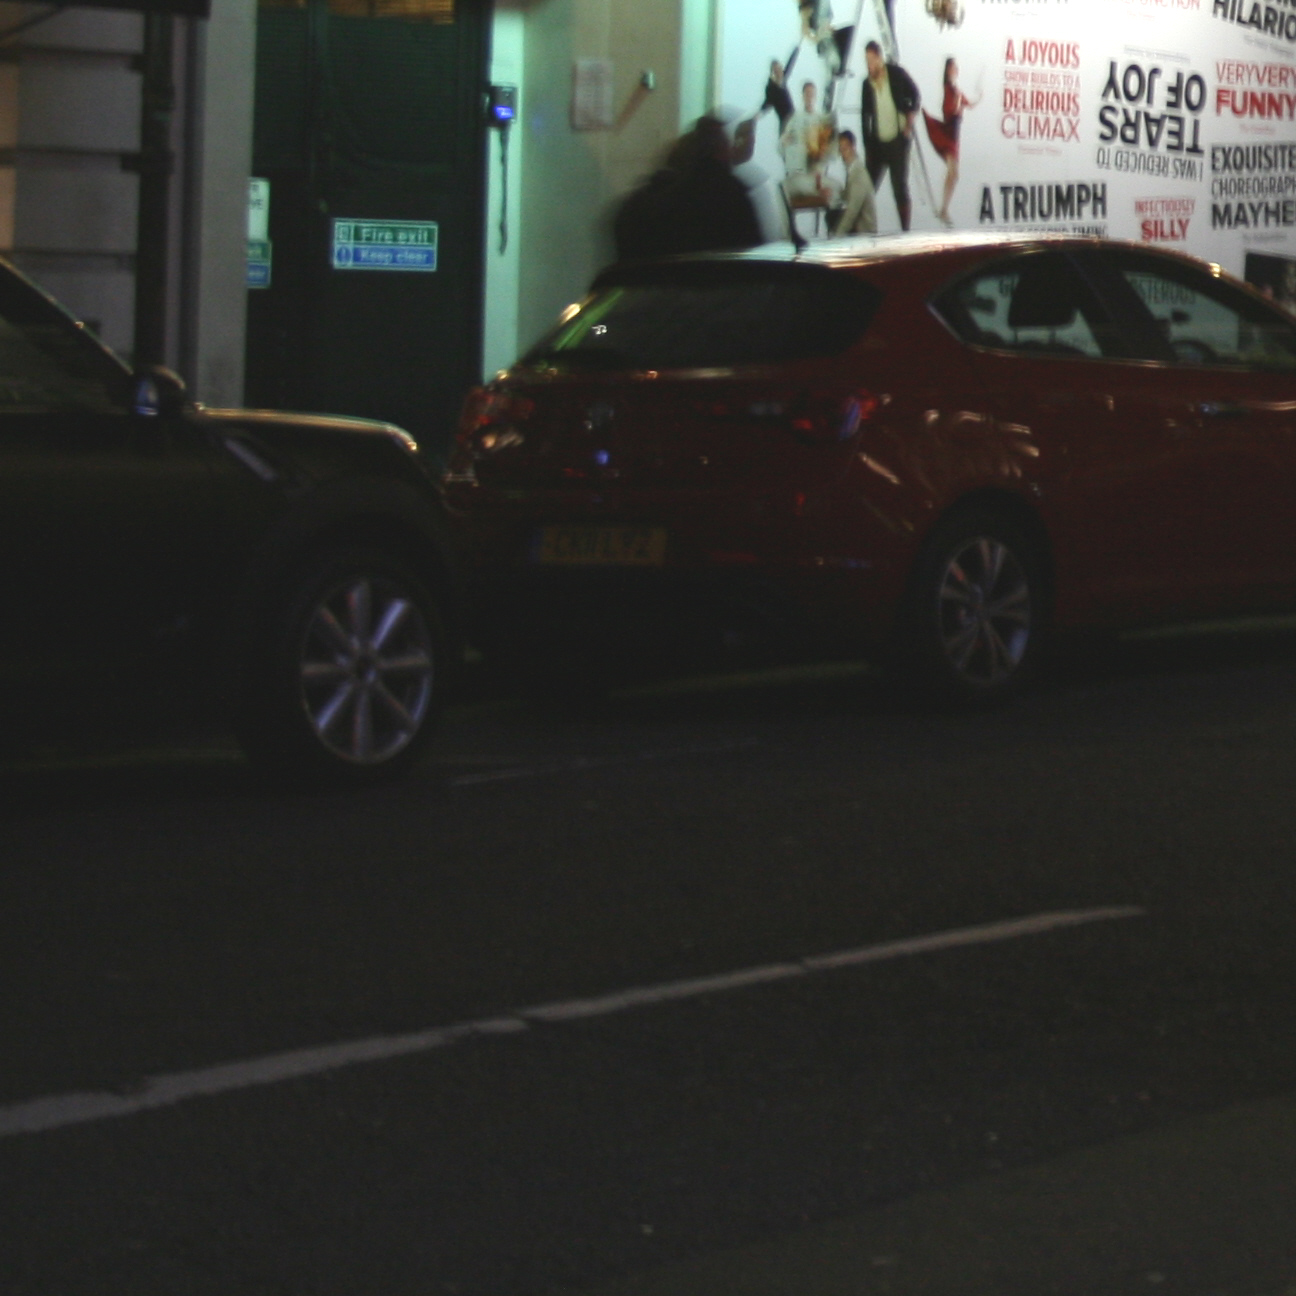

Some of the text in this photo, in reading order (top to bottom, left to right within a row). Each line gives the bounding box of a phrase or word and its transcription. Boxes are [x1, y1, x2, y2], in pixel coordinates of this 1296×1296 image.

[1005, 38, 1081, 71] A JOYOUS
[1102, 60, 1208, 113] OF JOY
[1003, 87, 1080, 119] DELIRIOUS
[1001, 113, 1081, 143] CLIMAX
[1099, 104, 1205, 158] TEARS
[1114, 149, 1170, 177] REDUCED
[1172, 157, 1197, 182] WAS
[978, 180, 1107, 224] A TRIUMPH
[361, 227, 428, 245] Fire exit
[1140, 218, 1191, 242] SILLY
[360, 248, 428, 265] Keep clear
